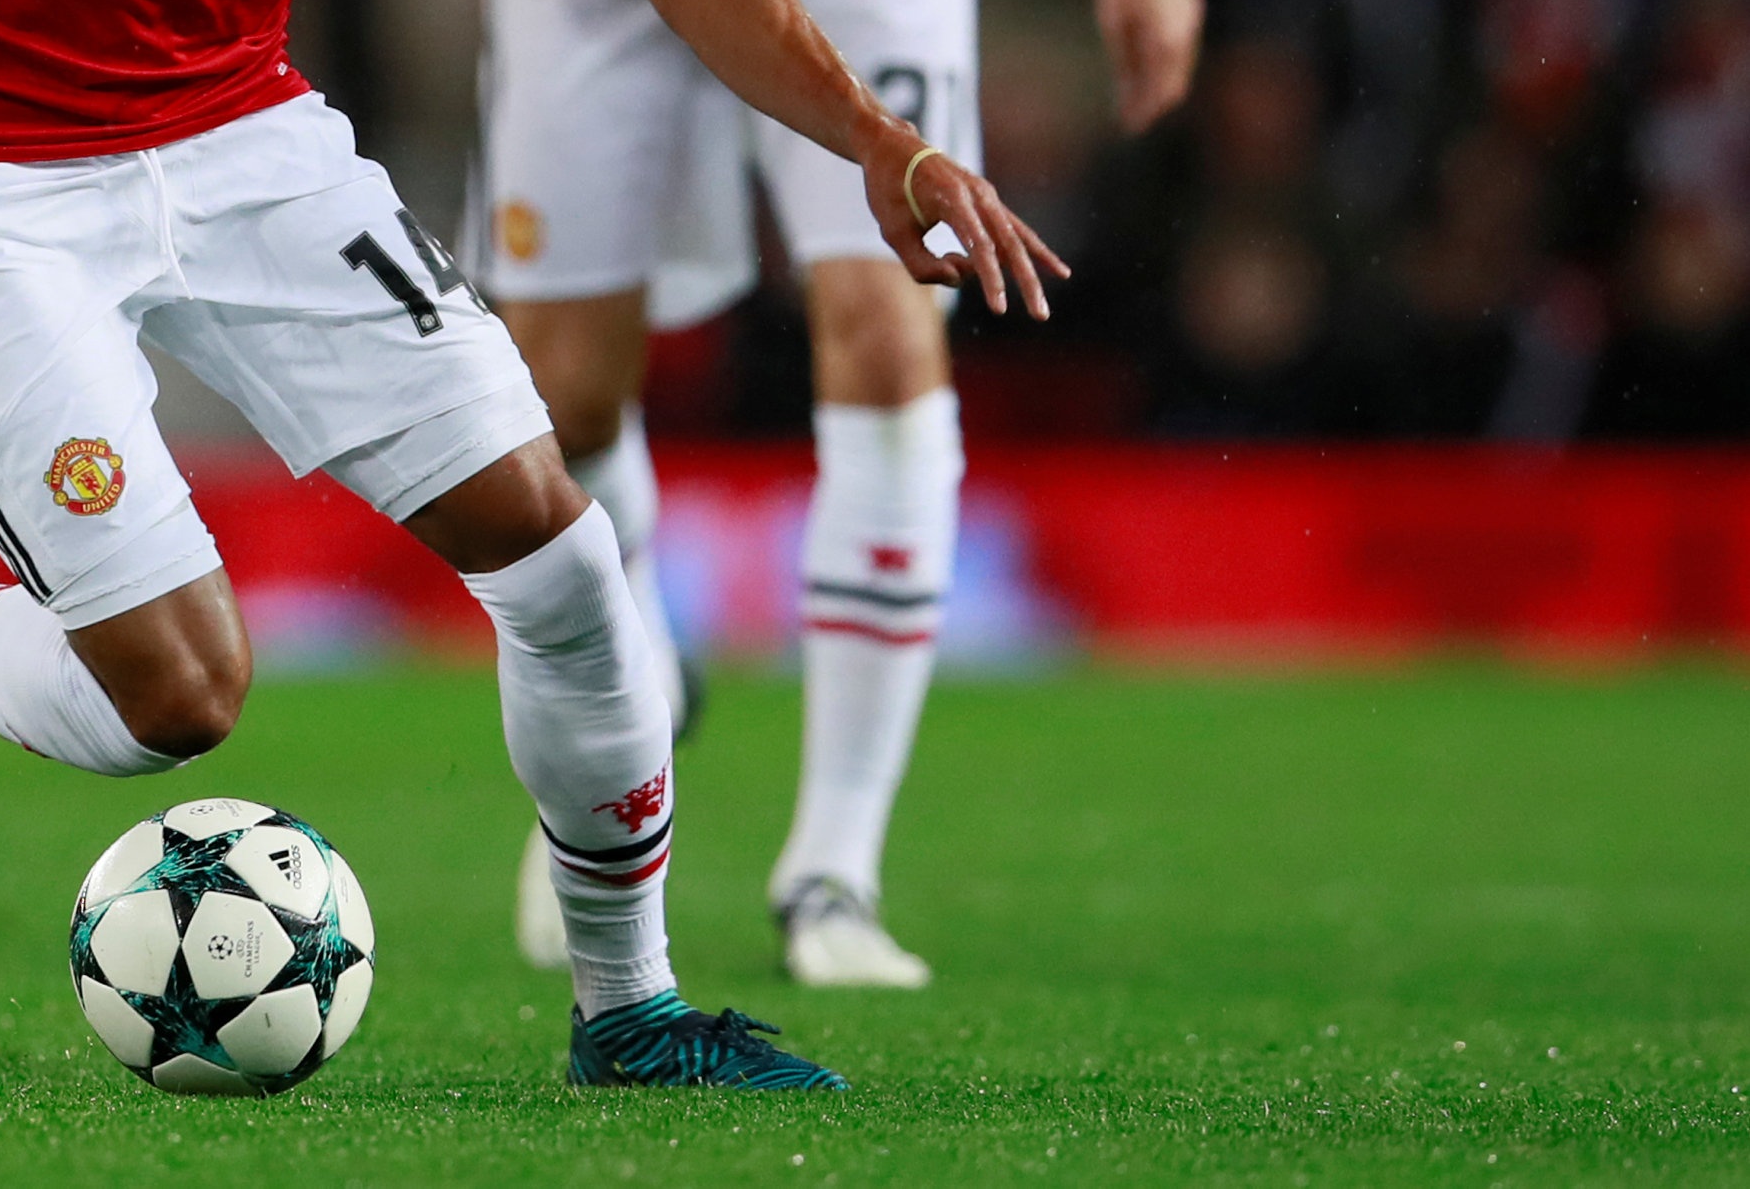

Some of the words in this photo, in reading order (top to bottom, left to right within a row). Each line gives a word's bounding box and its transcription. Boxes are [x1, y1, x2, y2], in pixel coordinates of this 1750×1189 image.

[338, 207, 491, 338] 14
[53, 443, 106, 484] MANCHESTER
[82, 484, 121, 512] UNITED
[291, 844, 302, 890] adidas
[244, 921, 255, 978] CHAMPIONS
